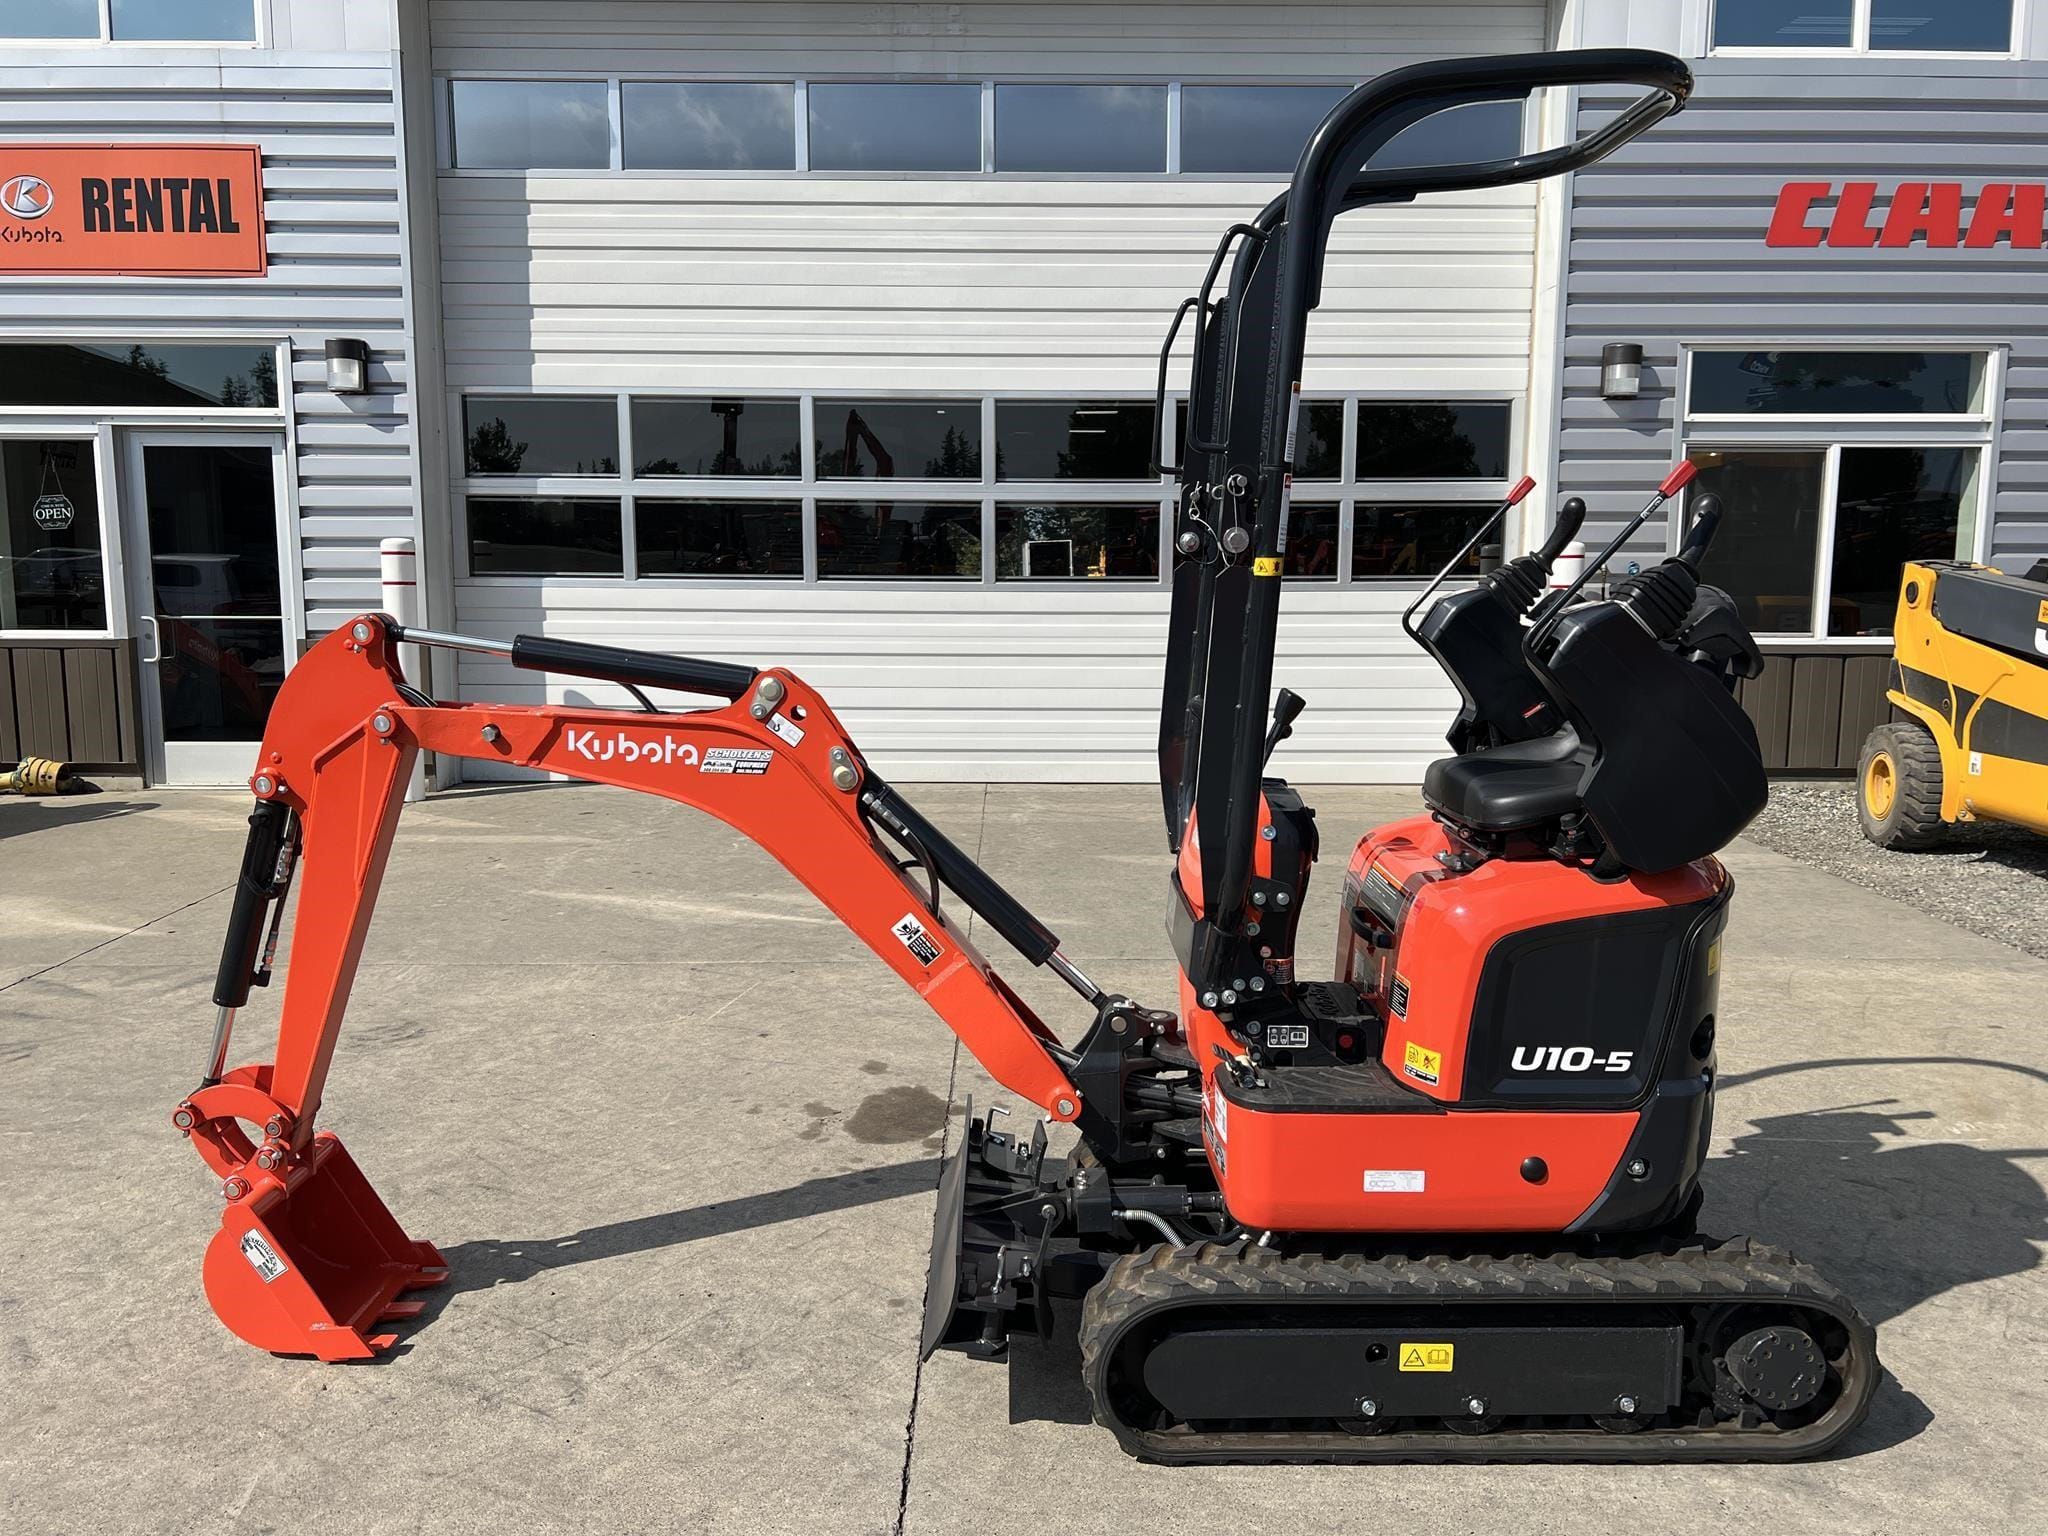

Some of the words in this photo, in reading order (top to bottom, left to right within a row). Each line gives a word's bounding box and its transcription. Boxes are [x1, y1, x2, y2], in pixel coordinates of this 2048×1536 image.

[81, 177, 240, 233] RENTAL
[1766, 182, 2048, 249] CLAA
[1, 226, 63, 243] Kubota
[36, 507, 71, 520] OPEN
[567, 730, 698, 765] Kubota
[706, 750, 771, 760] SCHOLTEN'S
[1511, 1046, 1634, 1072] U10-5
